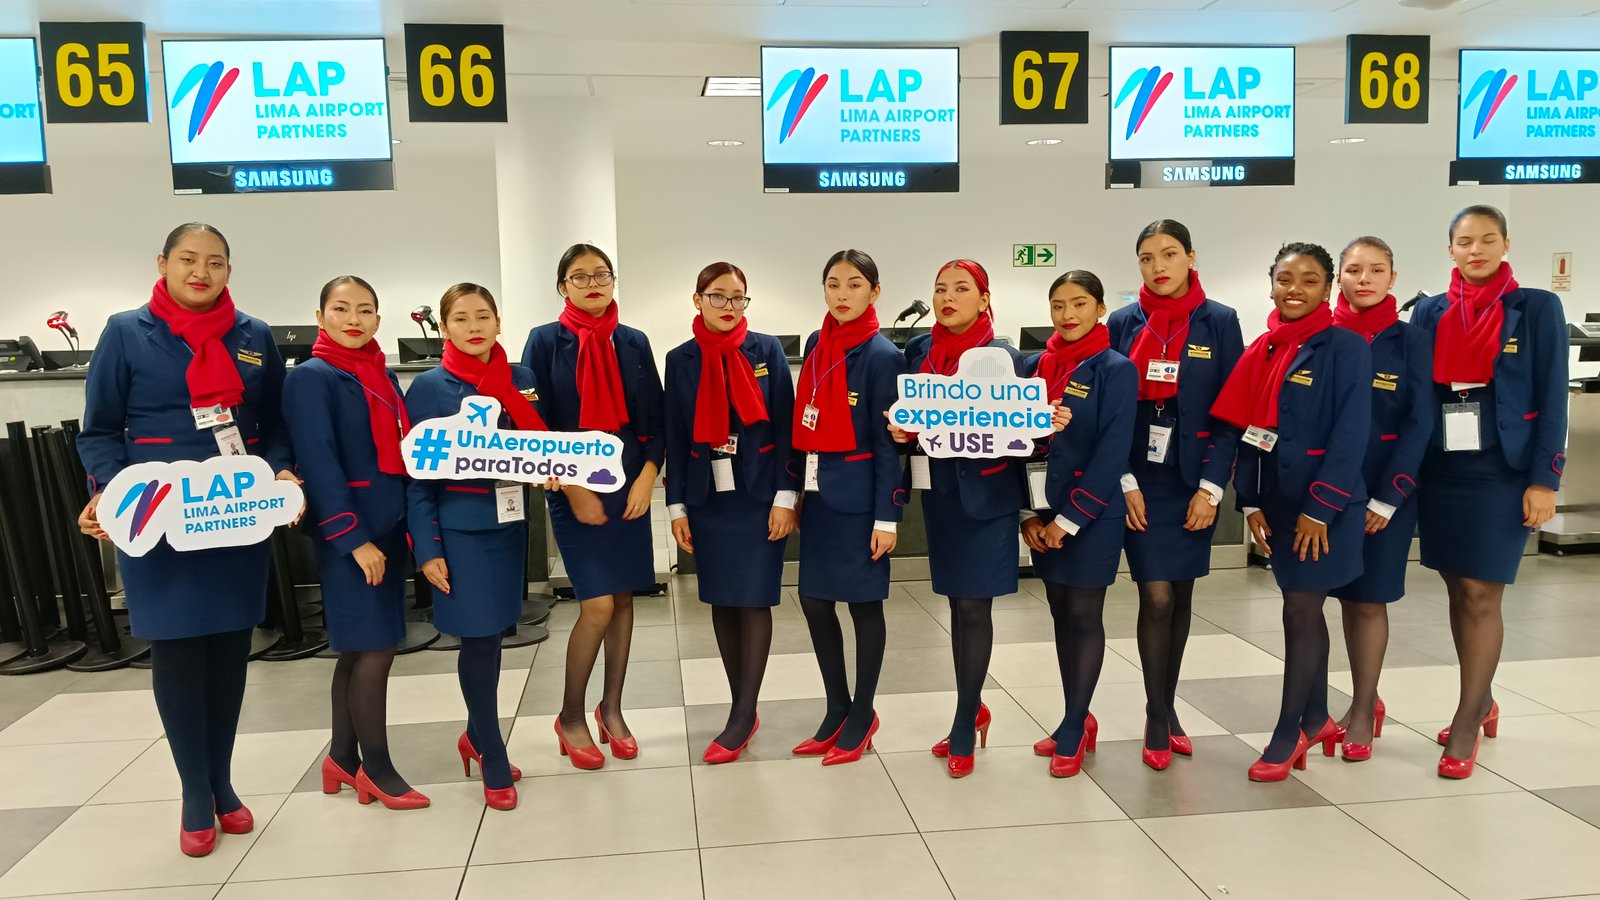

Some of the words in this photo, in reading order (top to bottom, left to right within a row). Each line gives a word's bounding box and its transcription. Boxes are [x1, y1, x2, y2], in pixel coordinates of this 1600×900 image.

[56, 43, 135, 107] 65
[252, 61, 345, 97] LAP
[420, 44, 495, 107] 66
[840, 69, 922, 102] LAP
[1013, 50, 1079, 110] 67
[1184, 67, 1261, 99] LAP
[1360, 52, 1421, 109] 68
[1527, 69, 1599, 101] LAP
[255, 103, 301, 118] LIMA
[306, 102, 384, 117] AIRPORT
[840, 109, 880, 122] LIMA
[885, 108, 955, 122] AIRPORT
[1184, 105, 1222, 118] LIMA
[1225, 105, 1291, 119] AIRPORT
[1526, 107, 1562, 119] LIMA
[1565, 106, 1600, 119] AIRP
[257, 124, 348, 139] PARTNERS
[841, 129, 921, 142] PARTNERS
[1184, 124, 1259, 137] PARTNERS
[1526, 125, 1595, 137] PARTNERS
[235, 169, 333, 188] SAMSUNG
[819, 171, 906, 187] SAMSUNG
[1163, 165, 1245, 181] SAMSUNG
[1505, 164, 1582, 180] SAMSUNG
[904, 378, 982, 400] Brindo
[990, 384, 1040, 400] una
[894, 406, 1051, 429] experiencia
[949, 432, 994, 454] USE
[455, 456, 578, 477] paraTodos
[181, 471, 255, 504] LAP
[183, 503, 220, 519] LIMA
[224, 497, 286, 515] AIRPORT
[185, 515, 257, 534] PARTNERS
